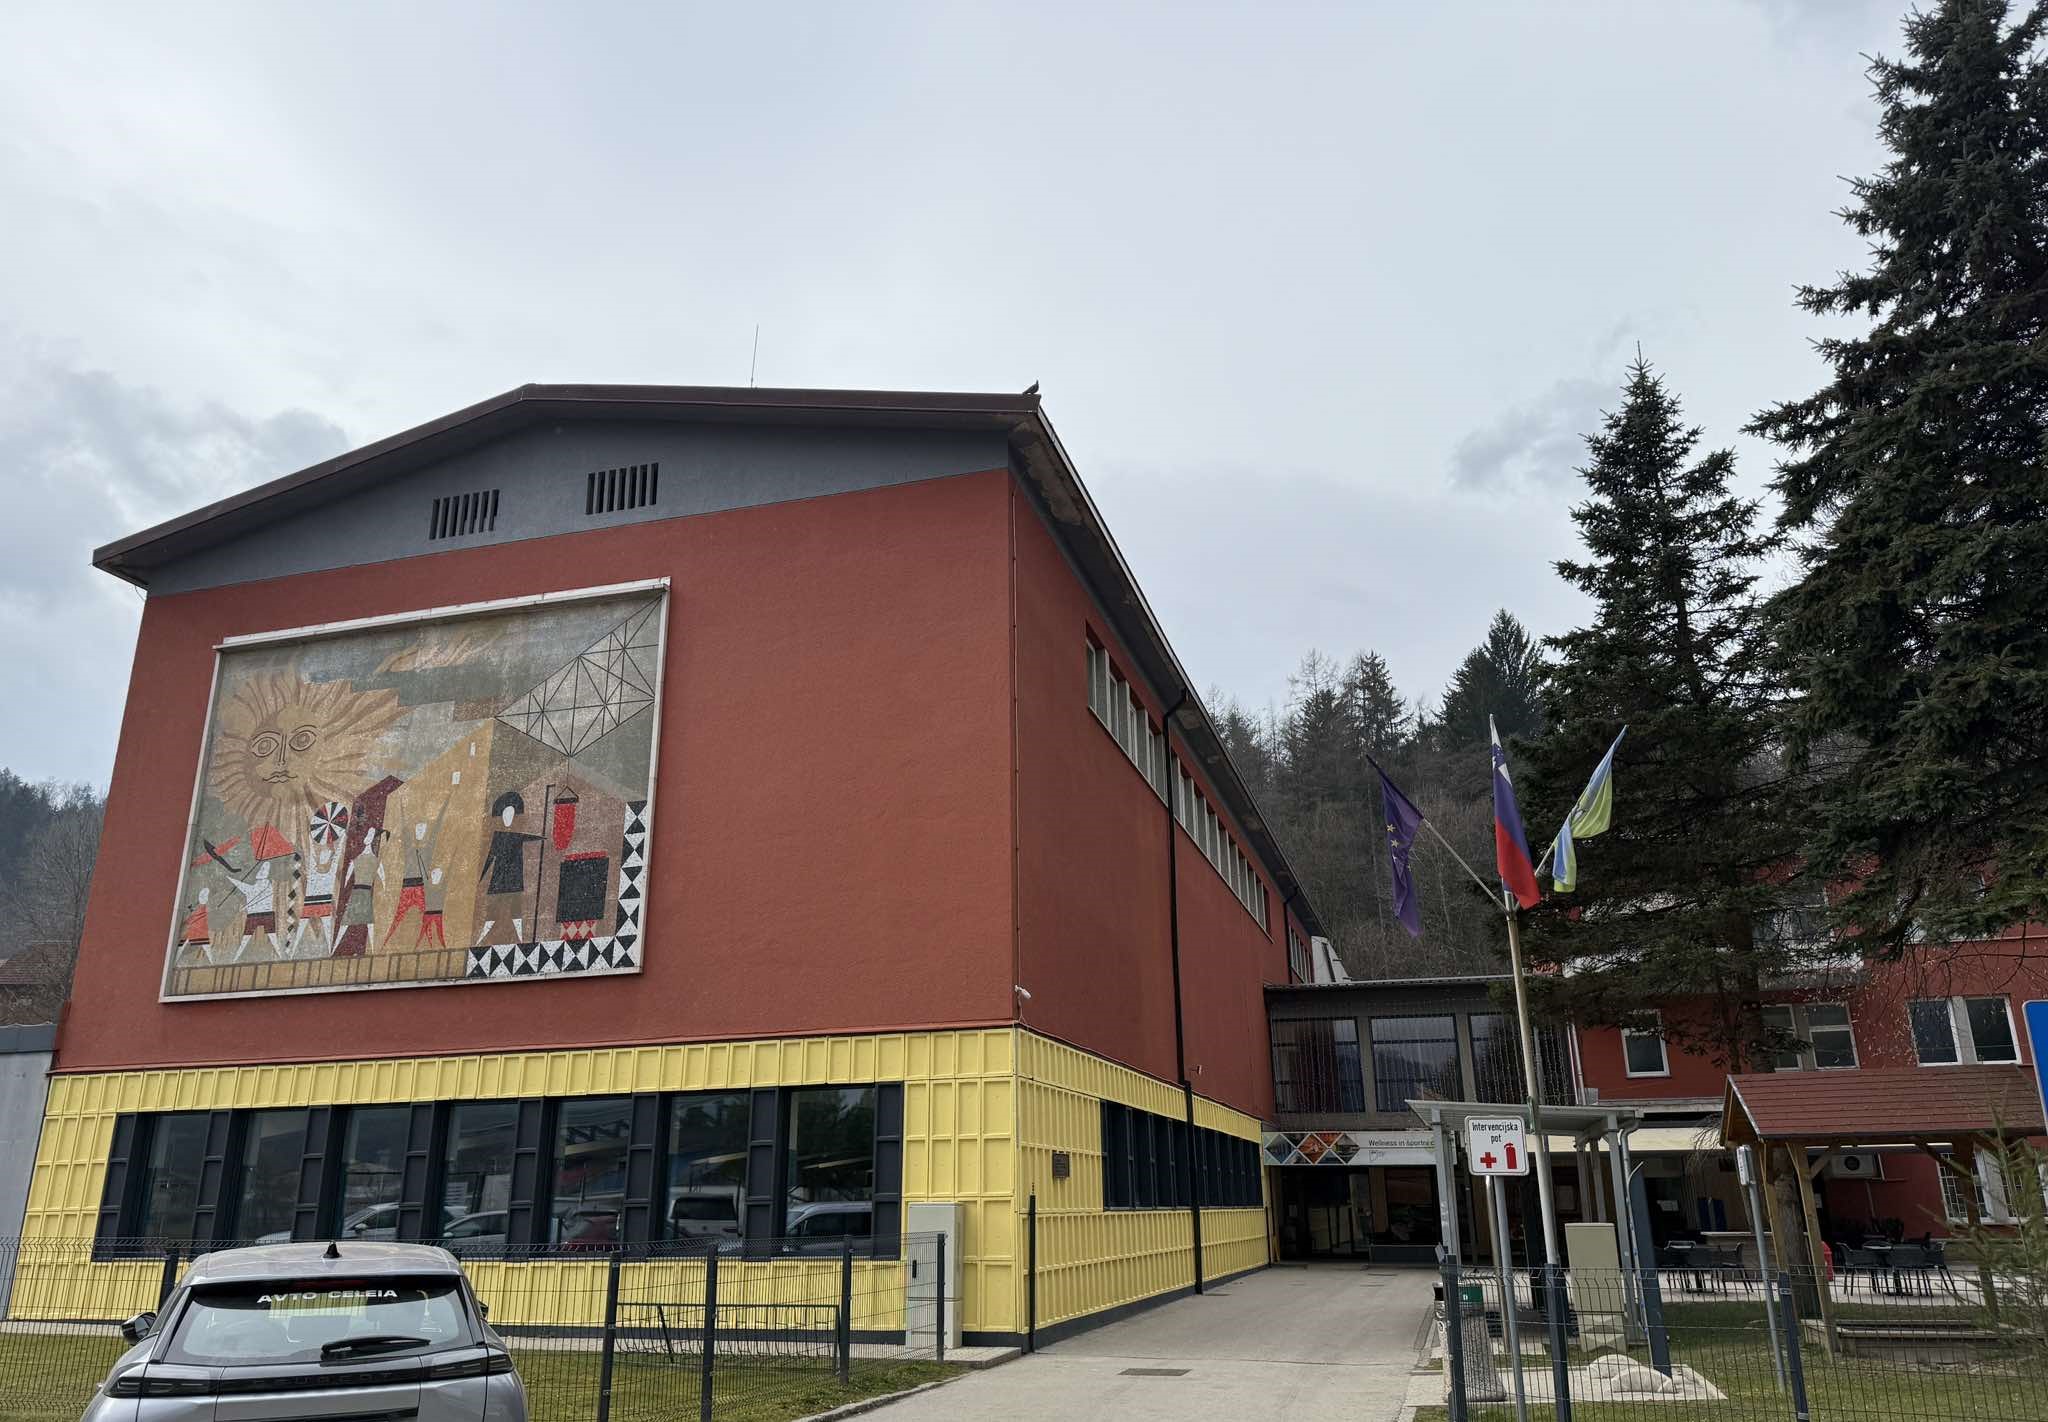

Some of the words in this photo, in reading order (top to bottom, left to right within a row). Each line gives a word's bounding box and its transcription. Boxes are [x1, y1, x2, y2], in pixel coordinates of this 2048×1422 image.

[1472, 1121, 1519, 1133] Intervencijska
[1491, 1134, 1502, 1145] pot
[257, 1292, 317, 1304] AVTO
[328, 1289, 398, 1299] CELEIA
